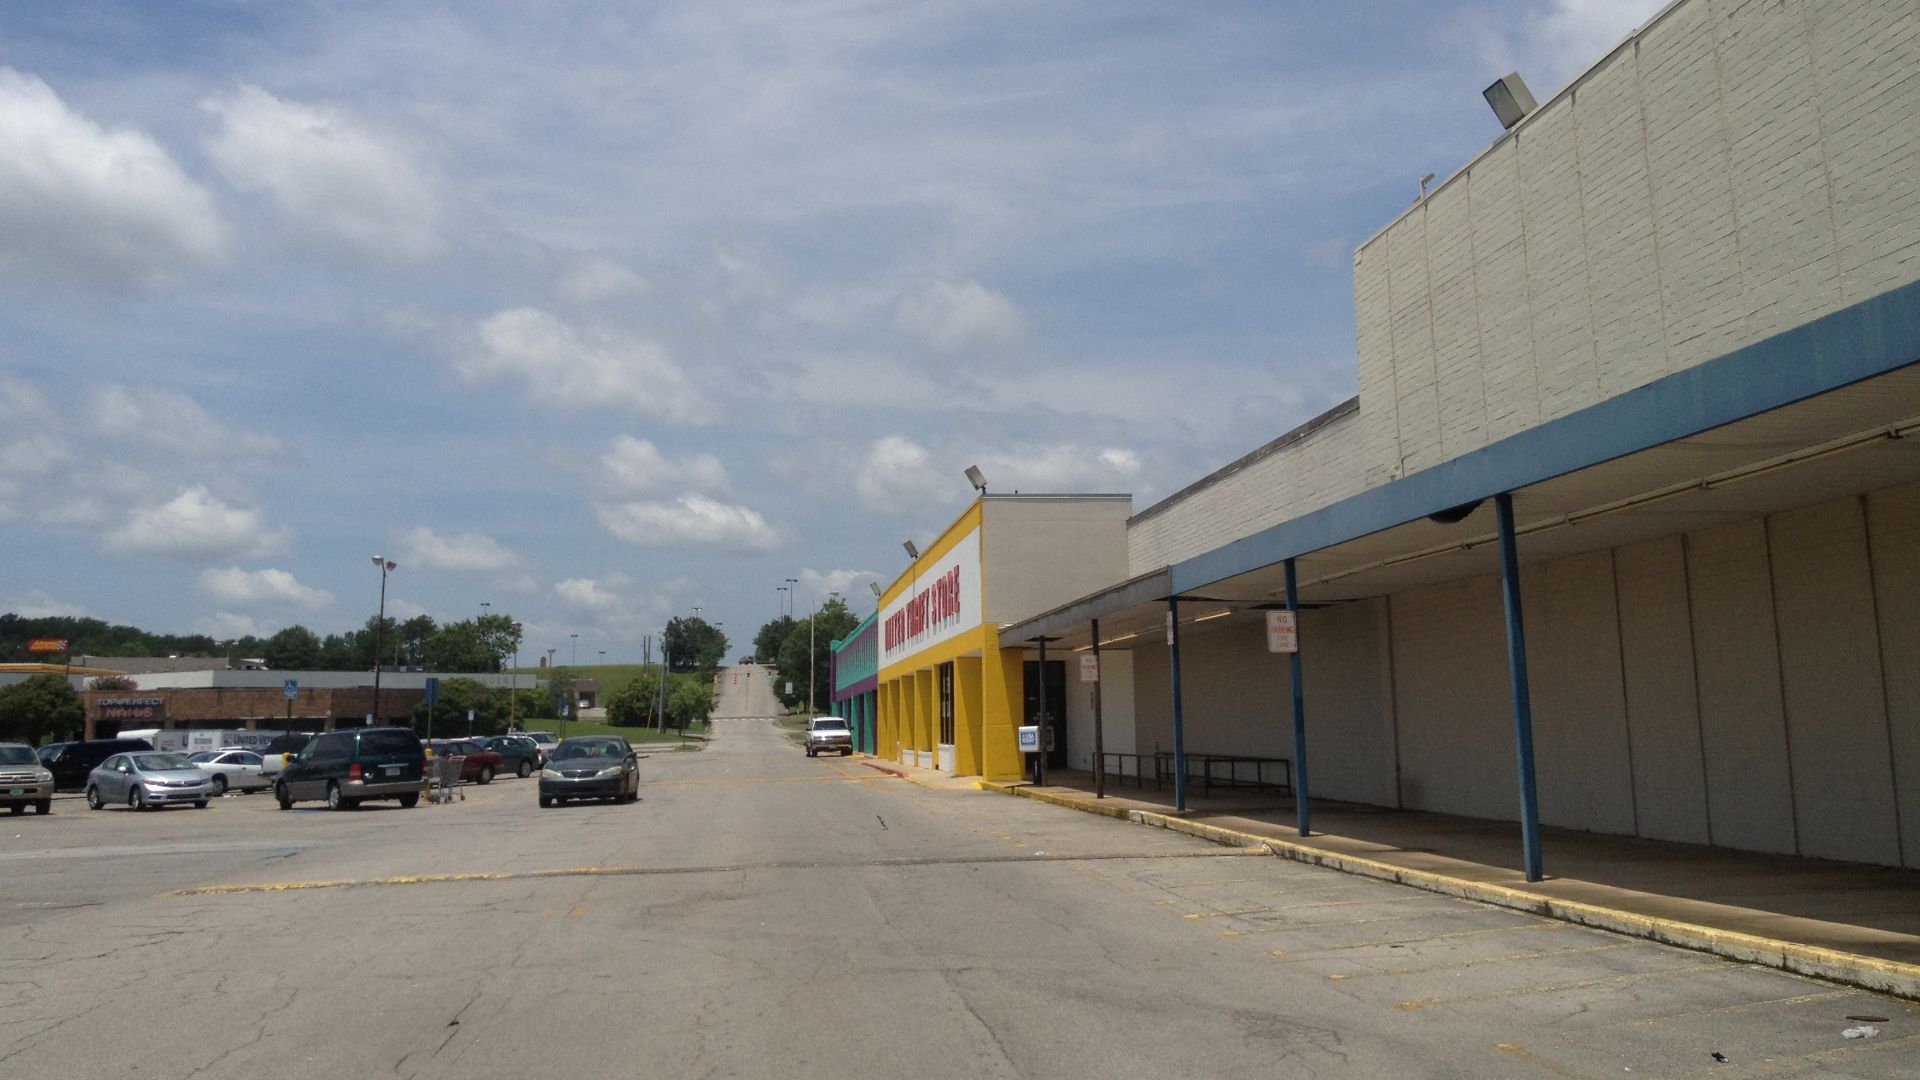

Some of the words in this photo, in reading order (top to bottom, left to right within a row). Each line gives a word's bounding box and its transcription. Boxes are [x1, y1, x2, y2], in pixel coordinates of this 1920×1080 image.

[932, 565, 960, 625] STORE
[1277, 616, 1288, 624] NO
[1271, 625, 1296, 634] PARKING
[105, 707, 153, 718] NAILS
